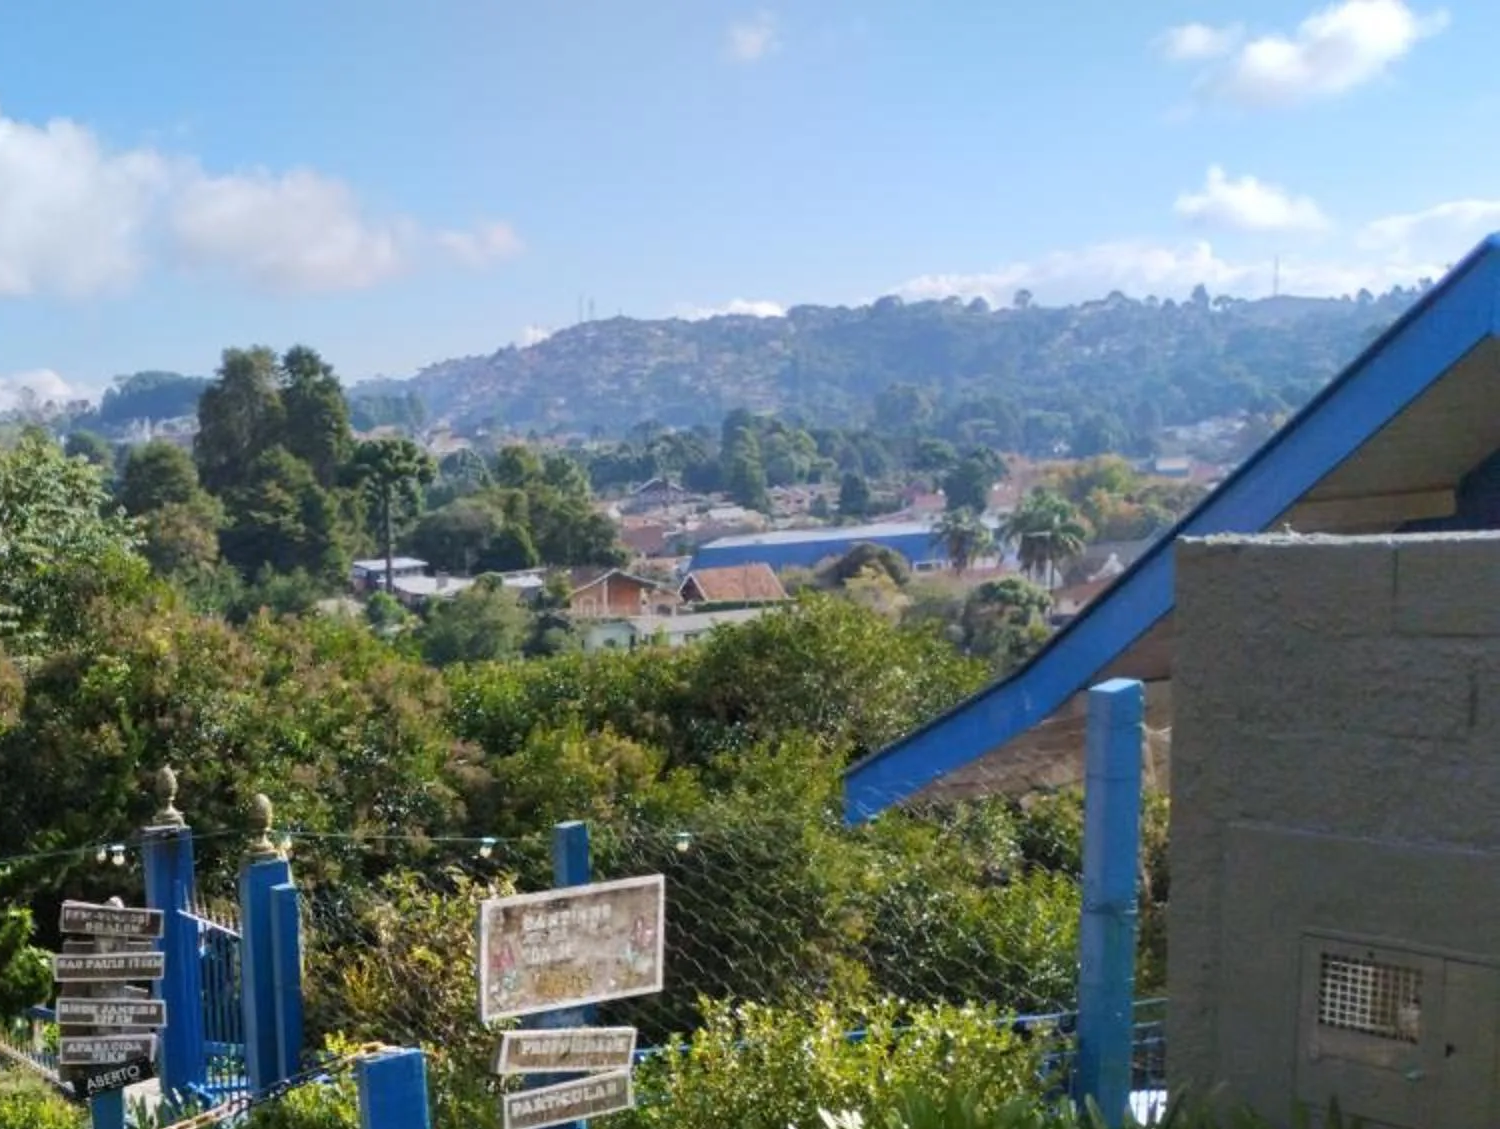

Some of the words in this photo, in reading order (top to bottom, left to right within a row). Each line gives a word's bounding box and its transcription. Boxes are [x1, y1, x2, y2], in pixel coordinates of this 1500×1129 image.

[101, 1004, 157, 1016] JANEIRO
[67, 1041, 142, 1053] APARECIDA
[87, 1065, 140, 1090] ABERTO
[511, 1082, 617, 1117] PARTICULAR
